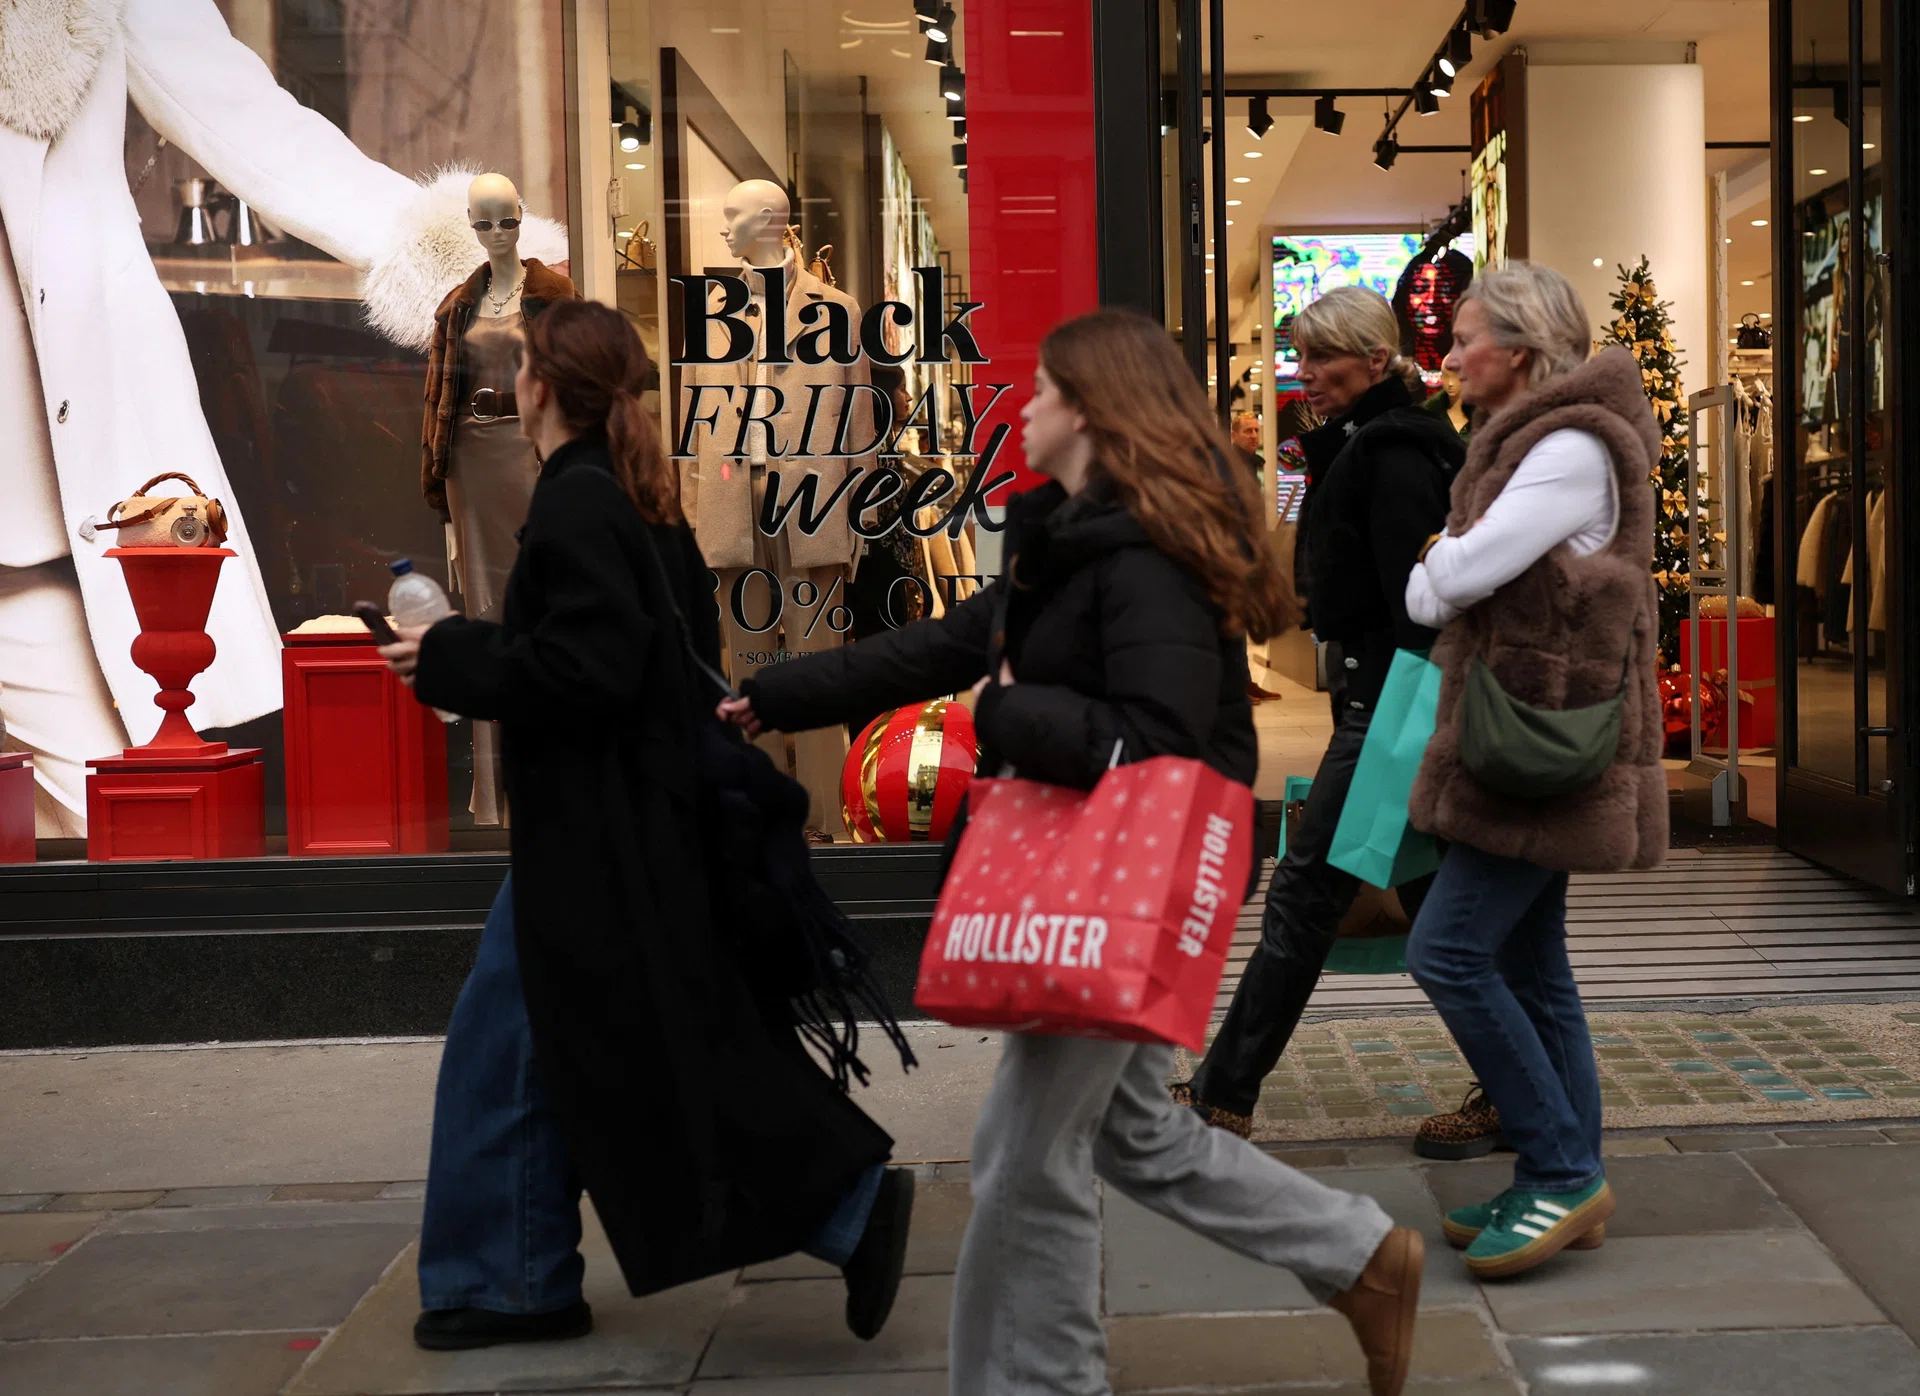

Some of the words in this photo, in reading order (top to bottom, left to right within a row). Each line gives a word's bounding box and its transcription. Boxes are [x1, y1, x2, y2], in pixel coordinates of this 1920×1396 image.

[670, 266, 991, 366] Black
[668, 383, 1014, 459] FRIDAY
[758, 422, 1017, 540] week
[709, 567, 854, 639] 0%
[876, 574, 1003, 632] OF
[1176, 812, 1234, 958] HOLLISTER
[943, 898, 1108, 969] HOLLISTER
